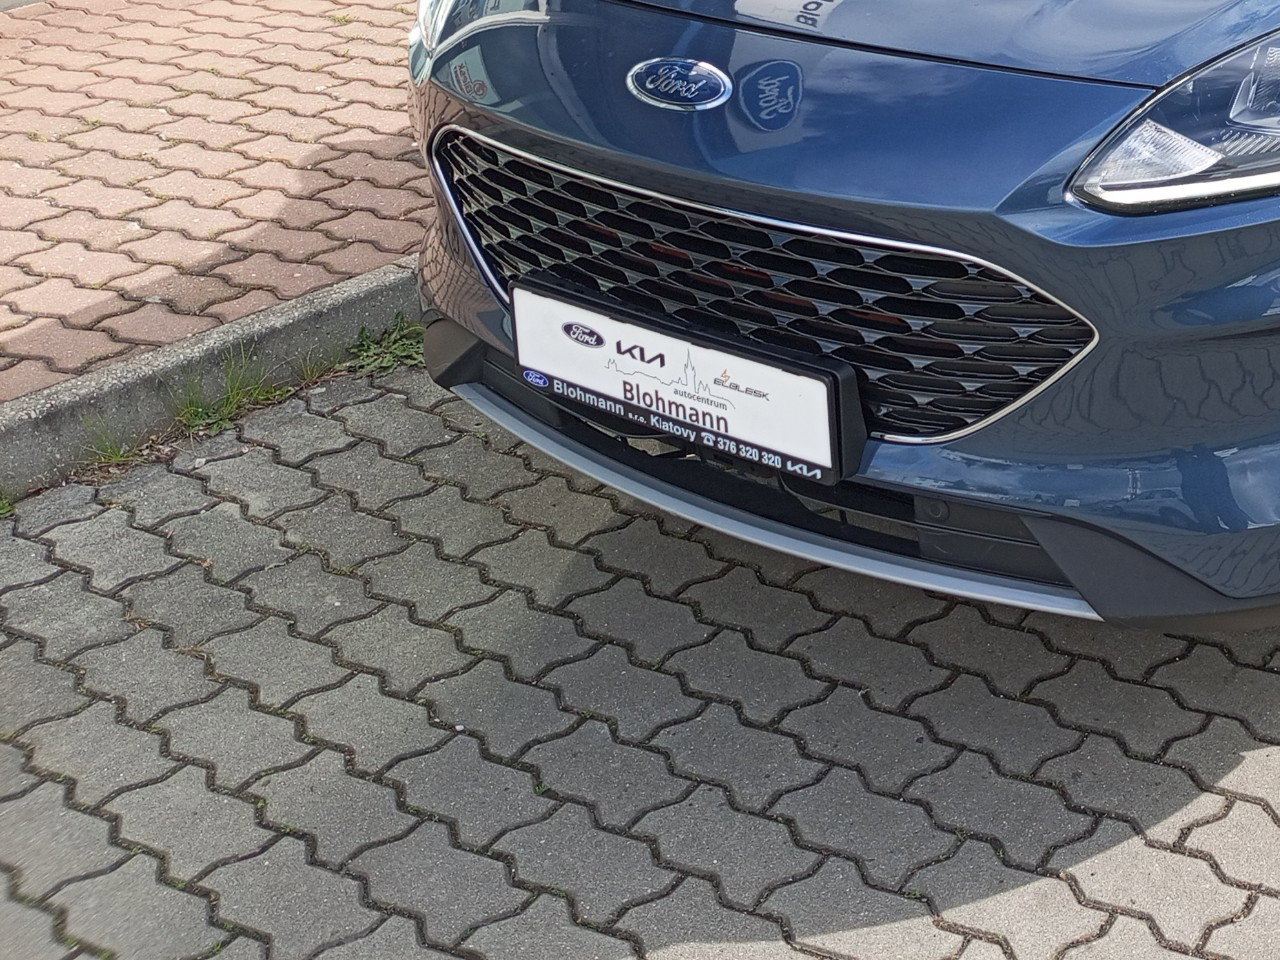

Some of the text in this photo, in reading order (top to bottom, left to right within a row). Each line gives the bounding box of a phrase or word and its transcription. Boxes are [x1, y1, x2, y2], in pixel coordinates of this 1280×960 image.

[645, 65, 707, 99] Ford
[569, 324, 597, 346] Ford
[673, 388, 728, 411] autocentrum
[713, 377, 770, 401] ELBLESK
[526, 371, 545, 386] Ford
[553, 379, 624, 416] Blohmann
[628, 412, 647, 424] s.r.o.
[650, 414, 697, 442] Klatovy
[717, 437, 737, 454] 376
[739, 444, 760, 461] 320
[761, 451, 782, 469] 320
[622, 380, 729, 433] Blohmann
